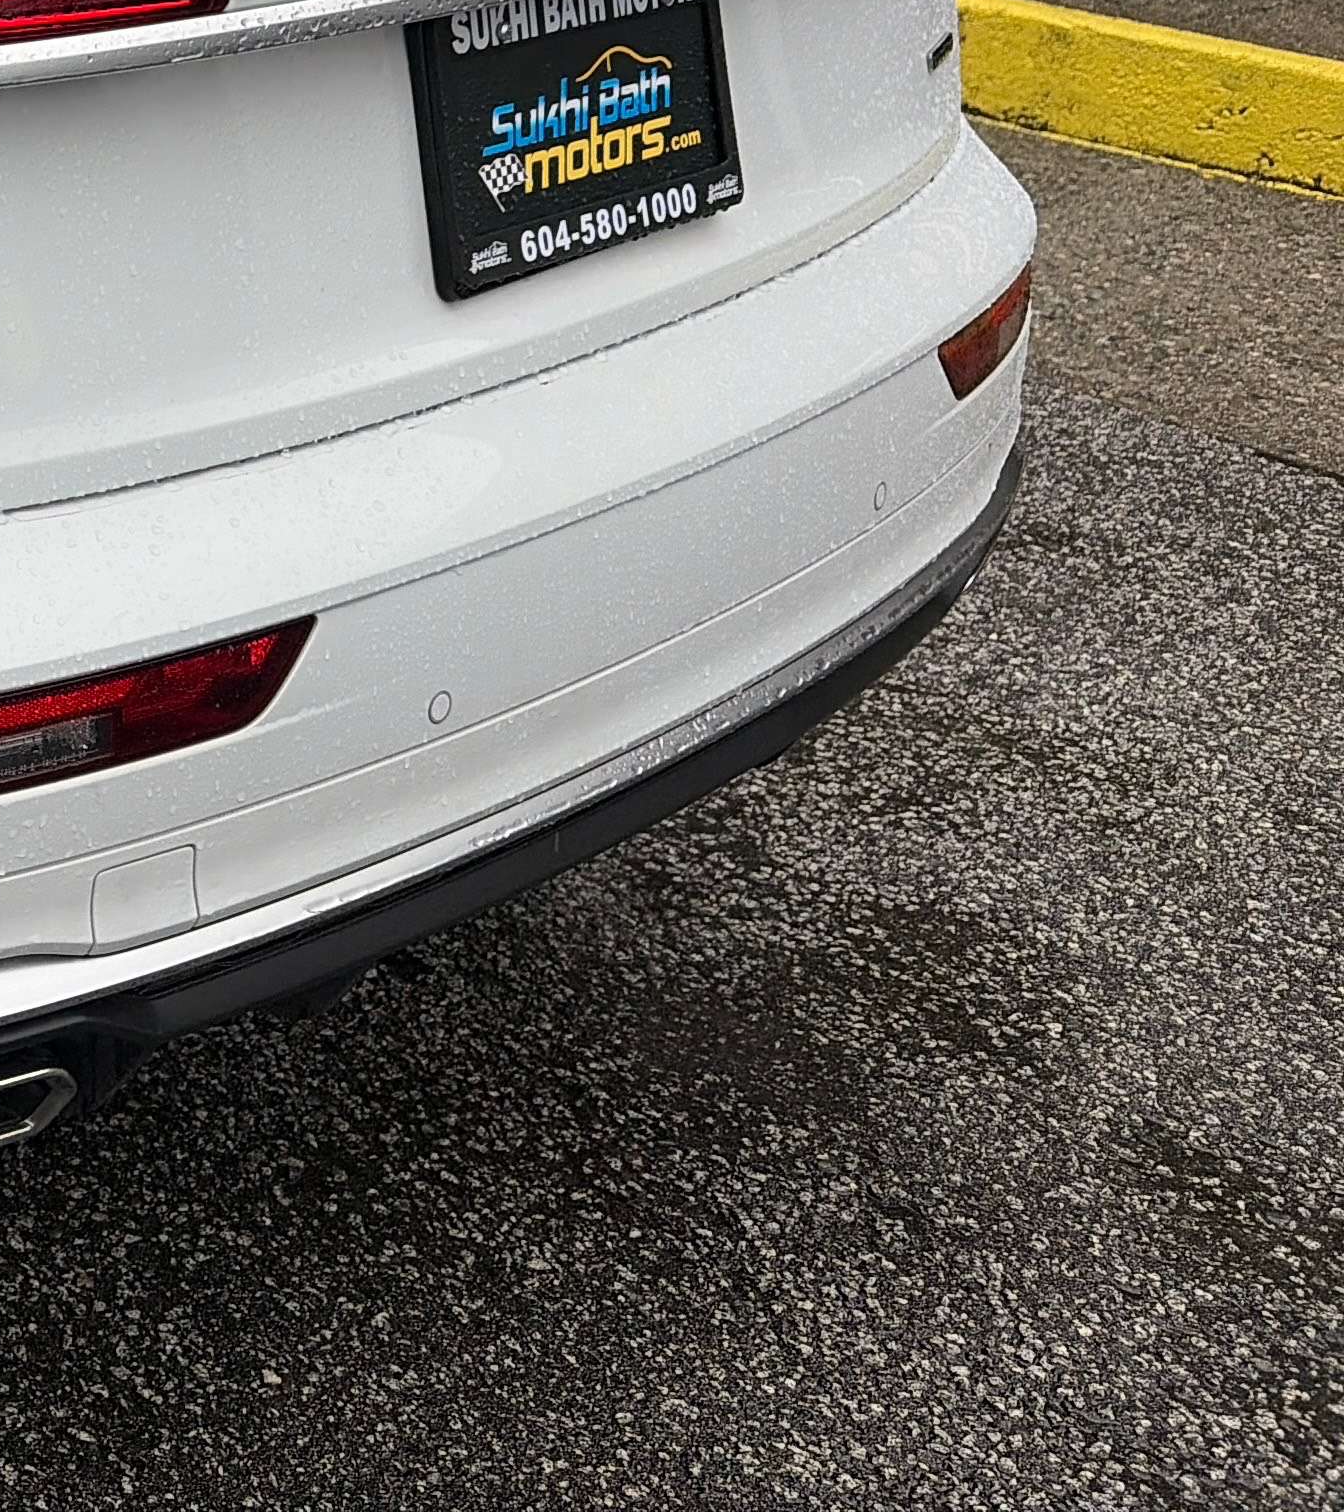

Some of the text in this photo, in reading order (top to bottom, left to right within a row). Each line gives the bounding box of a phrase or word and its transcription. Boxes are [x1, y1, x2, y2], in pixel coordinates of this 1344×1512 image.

[482, 67, 671, 157] Sukhi Bath
[521, 183, 697, 263] 604-580-1000
